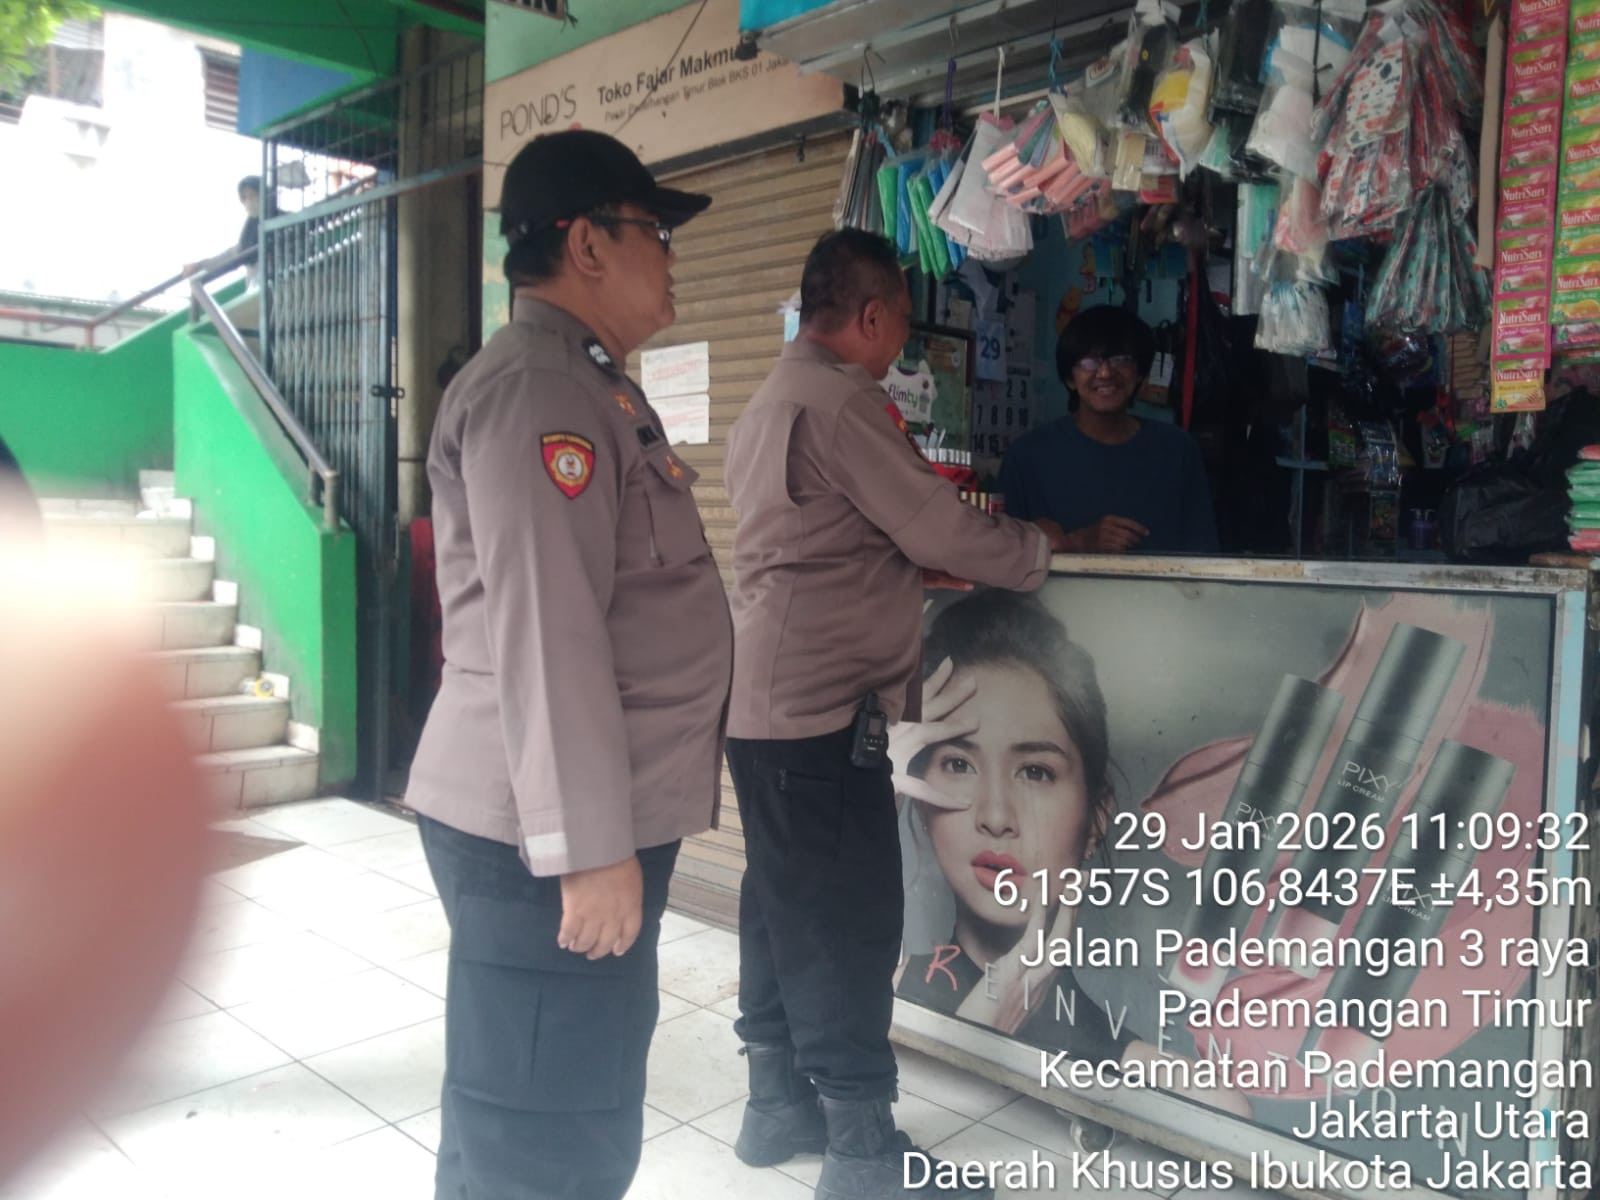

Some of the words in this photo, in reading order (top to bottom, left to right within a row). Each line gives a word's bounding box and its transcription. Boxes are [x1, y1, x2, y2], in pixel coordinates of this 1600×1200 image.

[598, 82, 631, 105] Toko
[637, 67, 675, 92] Fajar
[680, 46, 738, 78] Makmu
[708, 74, 726, 91] Blok
[729, 66, 749, 84] BKS
[751, 61, 763, 76] 01
[1514, 59, 1557, 77] NutriSari
[501, 84, 576, 140] POND'S
[1511, 123, 1553, 139] NutriSari
[1503, 186, 1545, 201] NutriSari
[1501, 247, 1543, 263] NutriSari
[1557, 275, 1598, 289] NutriSari
[1499, 310, 1542, 325] NutriSari
[981, 336, 1001, 361] 29
[1496, 367, 1538, 381] NutriSari
[1006, 378, 1013, 399] 2
[1020, 379, 1027, 400] 3
[977, 404, 983, 425] 7
[991, 405, 998, 426] 8
[1005, 406, 1013, 426] 9
[1342, 761, 1399, 793] PIXY
[1352, 784, 1385, 804] CREAM
